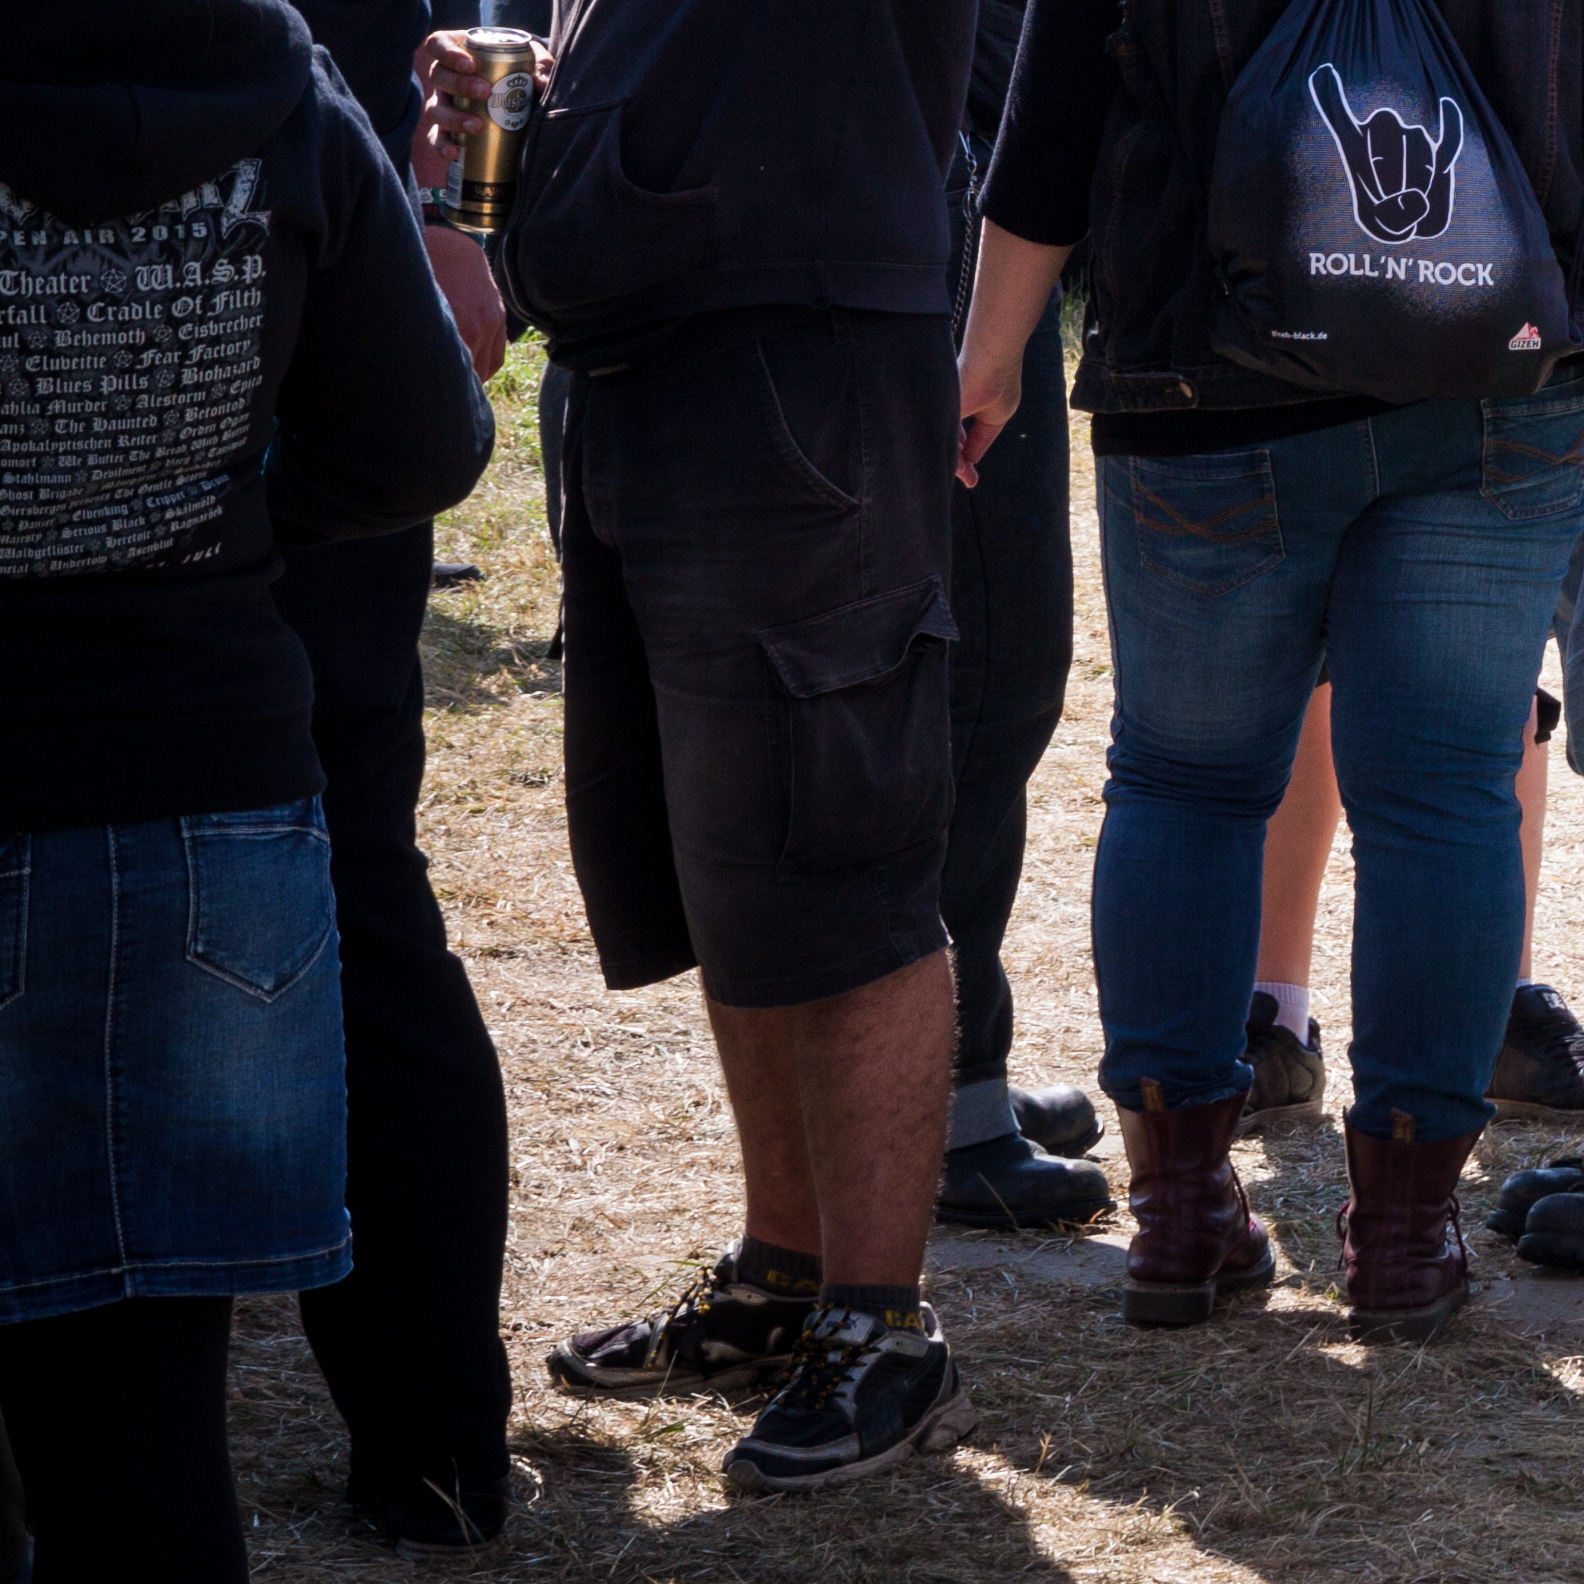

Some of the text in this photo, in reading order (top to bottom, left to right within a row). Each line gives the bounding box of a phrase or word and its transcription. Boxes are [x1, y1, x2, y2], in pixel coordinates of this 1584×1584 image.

[63, 228, 116, 246] AIR
[131, 222, 208, 244] 2015
[0, 269, 91, 299] Theater
[87, 302, 163, 323] Cradle
[171, 296, 203, 318] Of
[207, 287, 262, 317] Filth
[53, 329, 147, 350] Behemoth
[178, 314, 263, 341] Eisbrecher
[1510, 339, 1541, 349] GIZEH
[25, 337, 251, 372] Eluveitie Fear Factory
[35, 356, 260, 396] Blues Pills Biohazard
[45, 399, 108, 416] Murder
[136, 389, 206, 409] Alestorm
[231, 375, 263, 394] Epica
[54, 419, 86, 435] The
[93, 415, 158, 434] Haunted
[183, 398, 245, 424] Betontod
[117, 434, 158, 448] Reiter
[180, 424, 217, 440] Orden
[86, 453, 125, 467] Butter
[129, 450, 151, 462] The
[3, 472, 72, 486] Stahlmann
[137, 479, 173, 495] Gentle
[38, 487, 84, 502] Brigade
[72, 504, 128, 522] Elvenking
[60, 523, 107, 539] Serious
[111, 515, 147, 532] Black
